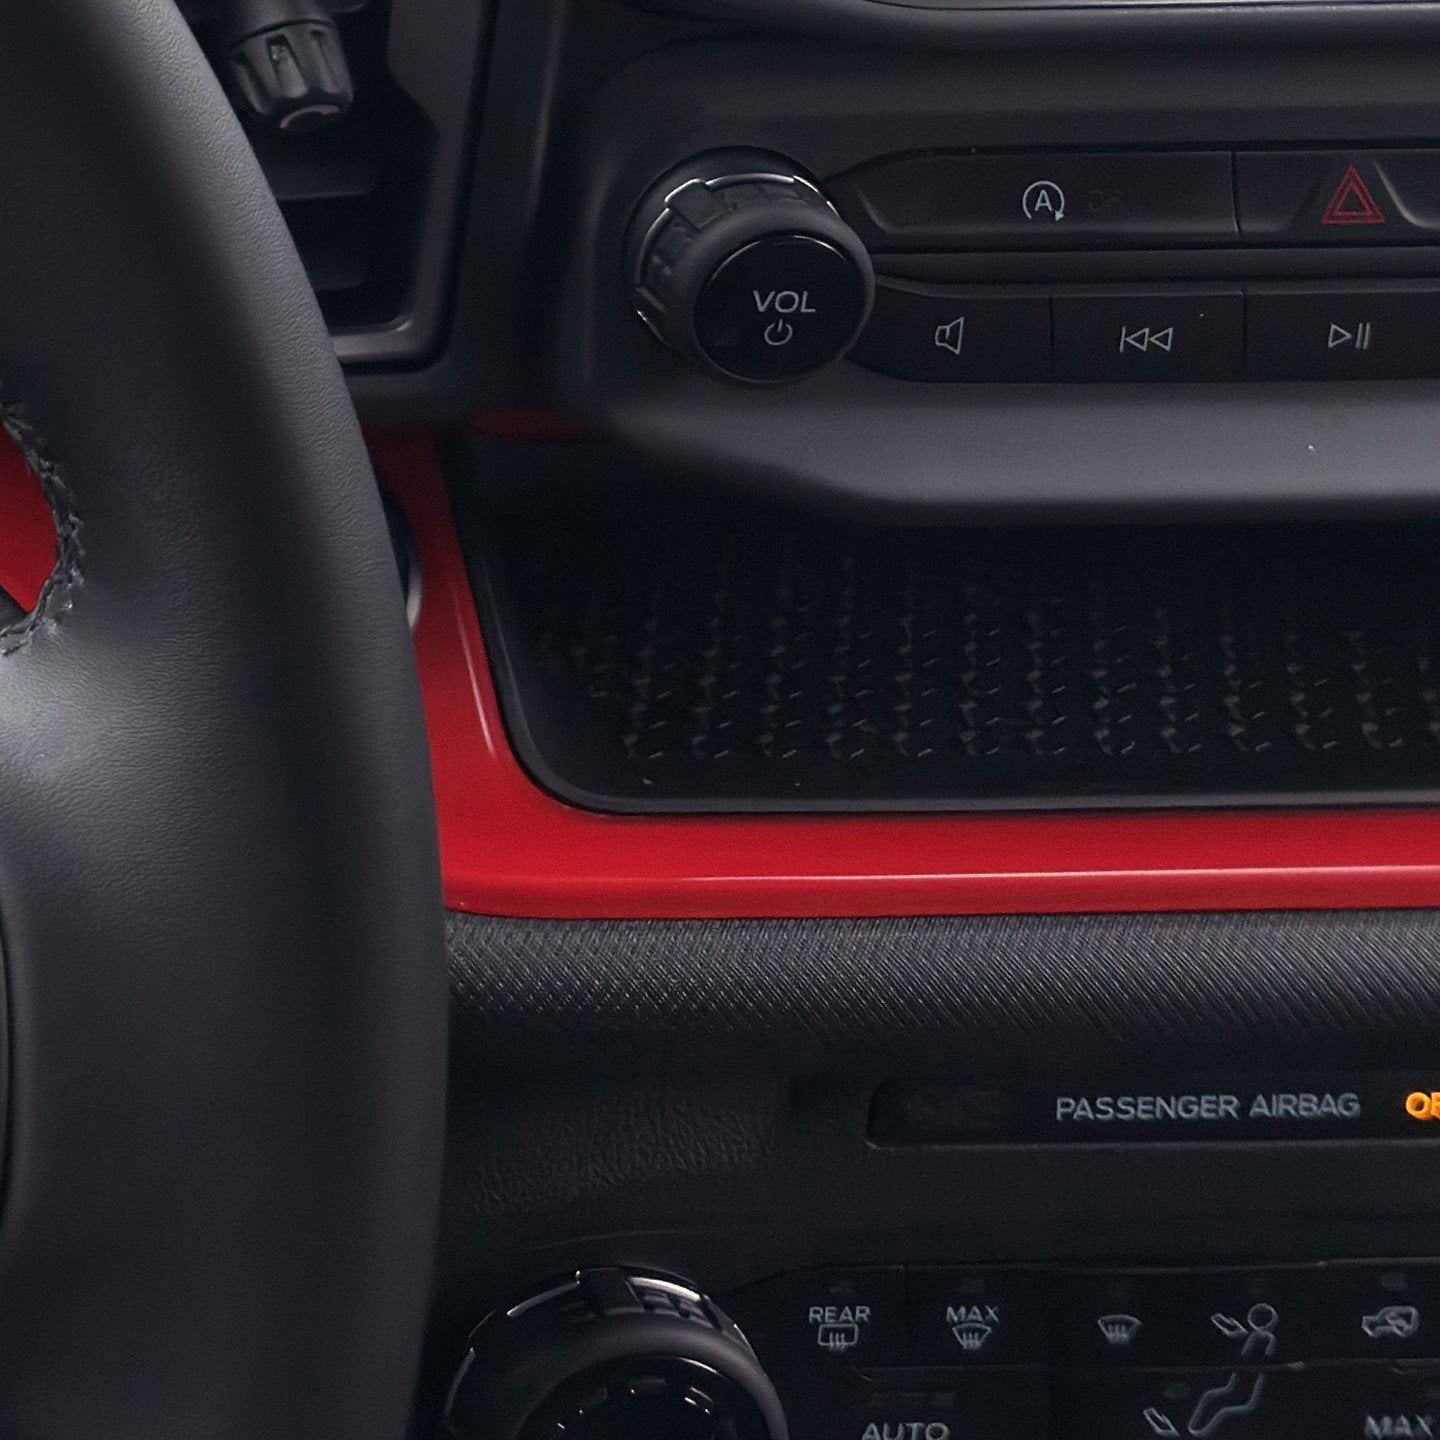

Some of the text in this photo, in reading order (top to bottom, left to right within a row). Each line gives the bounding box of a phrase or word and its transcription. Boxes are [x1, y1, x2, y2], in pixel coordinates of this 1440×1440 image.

[753, 290, 816, 314] VOL
[1056, 1094, 1240, 1121] PASSENGER
[1249, 1092, 1360, 1118] AIRBAG
[807, 1304, 873, 1324] REAR
[945, 1304, 1001, 1323] MAX
[861, 1422, 950, 1440] AUTO
